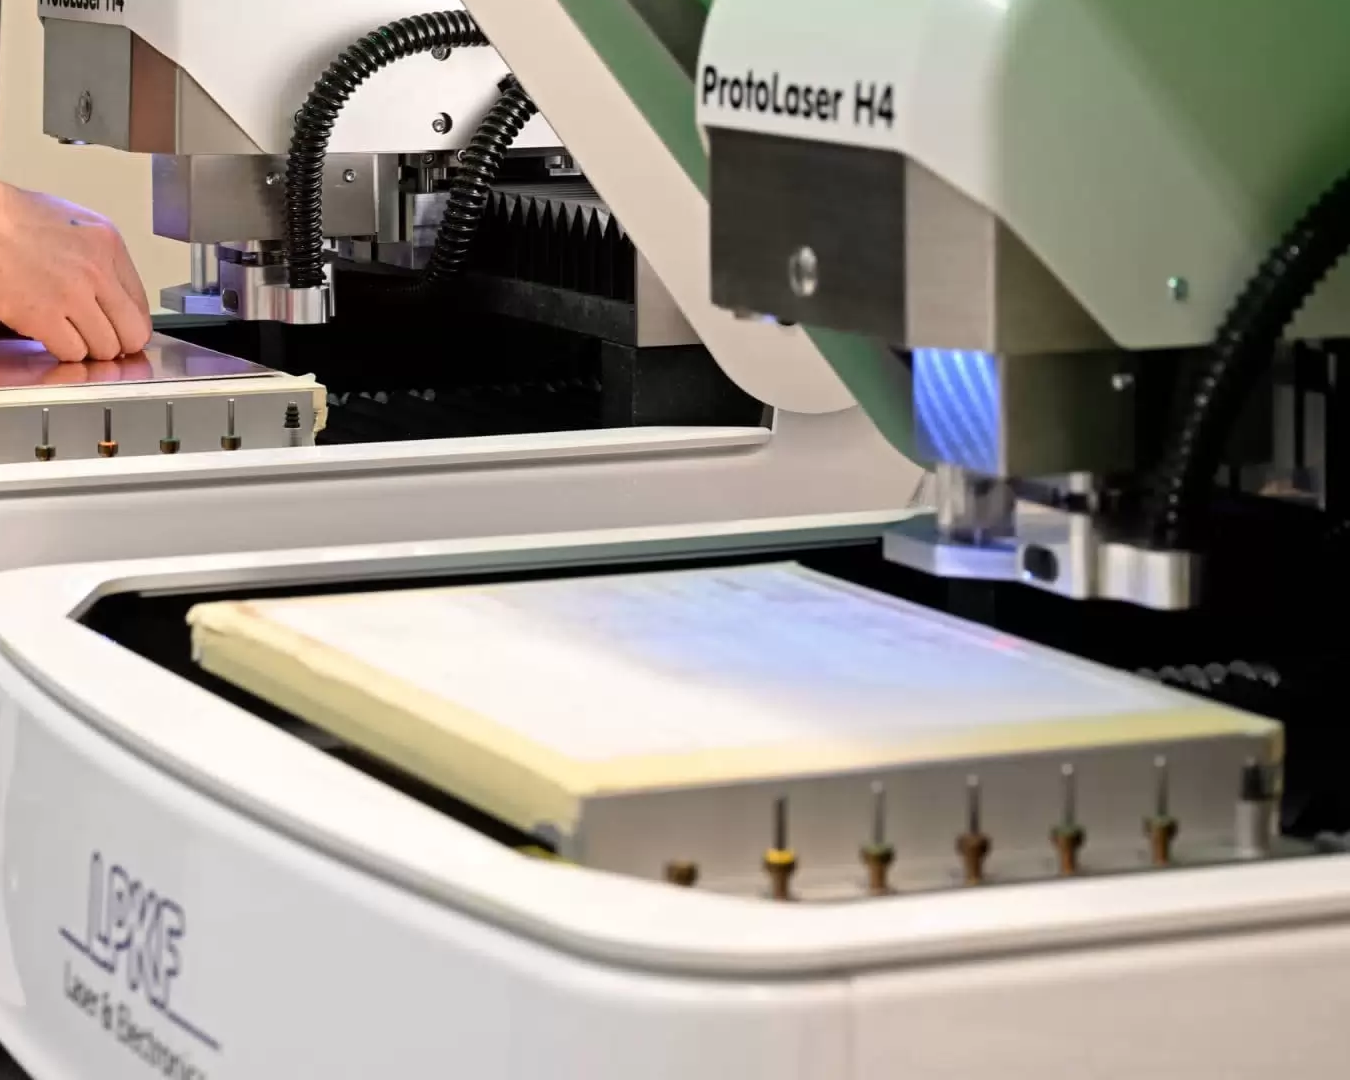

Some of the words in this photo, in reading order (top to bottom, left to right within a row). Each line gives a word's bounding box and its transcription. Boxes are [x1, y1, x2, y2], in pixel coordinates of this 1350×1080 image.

[701, 65, 844, 121] ProtoLaser
[854, 80, 895, 128] H4
[82, 850, 191, 1012] LPKF
